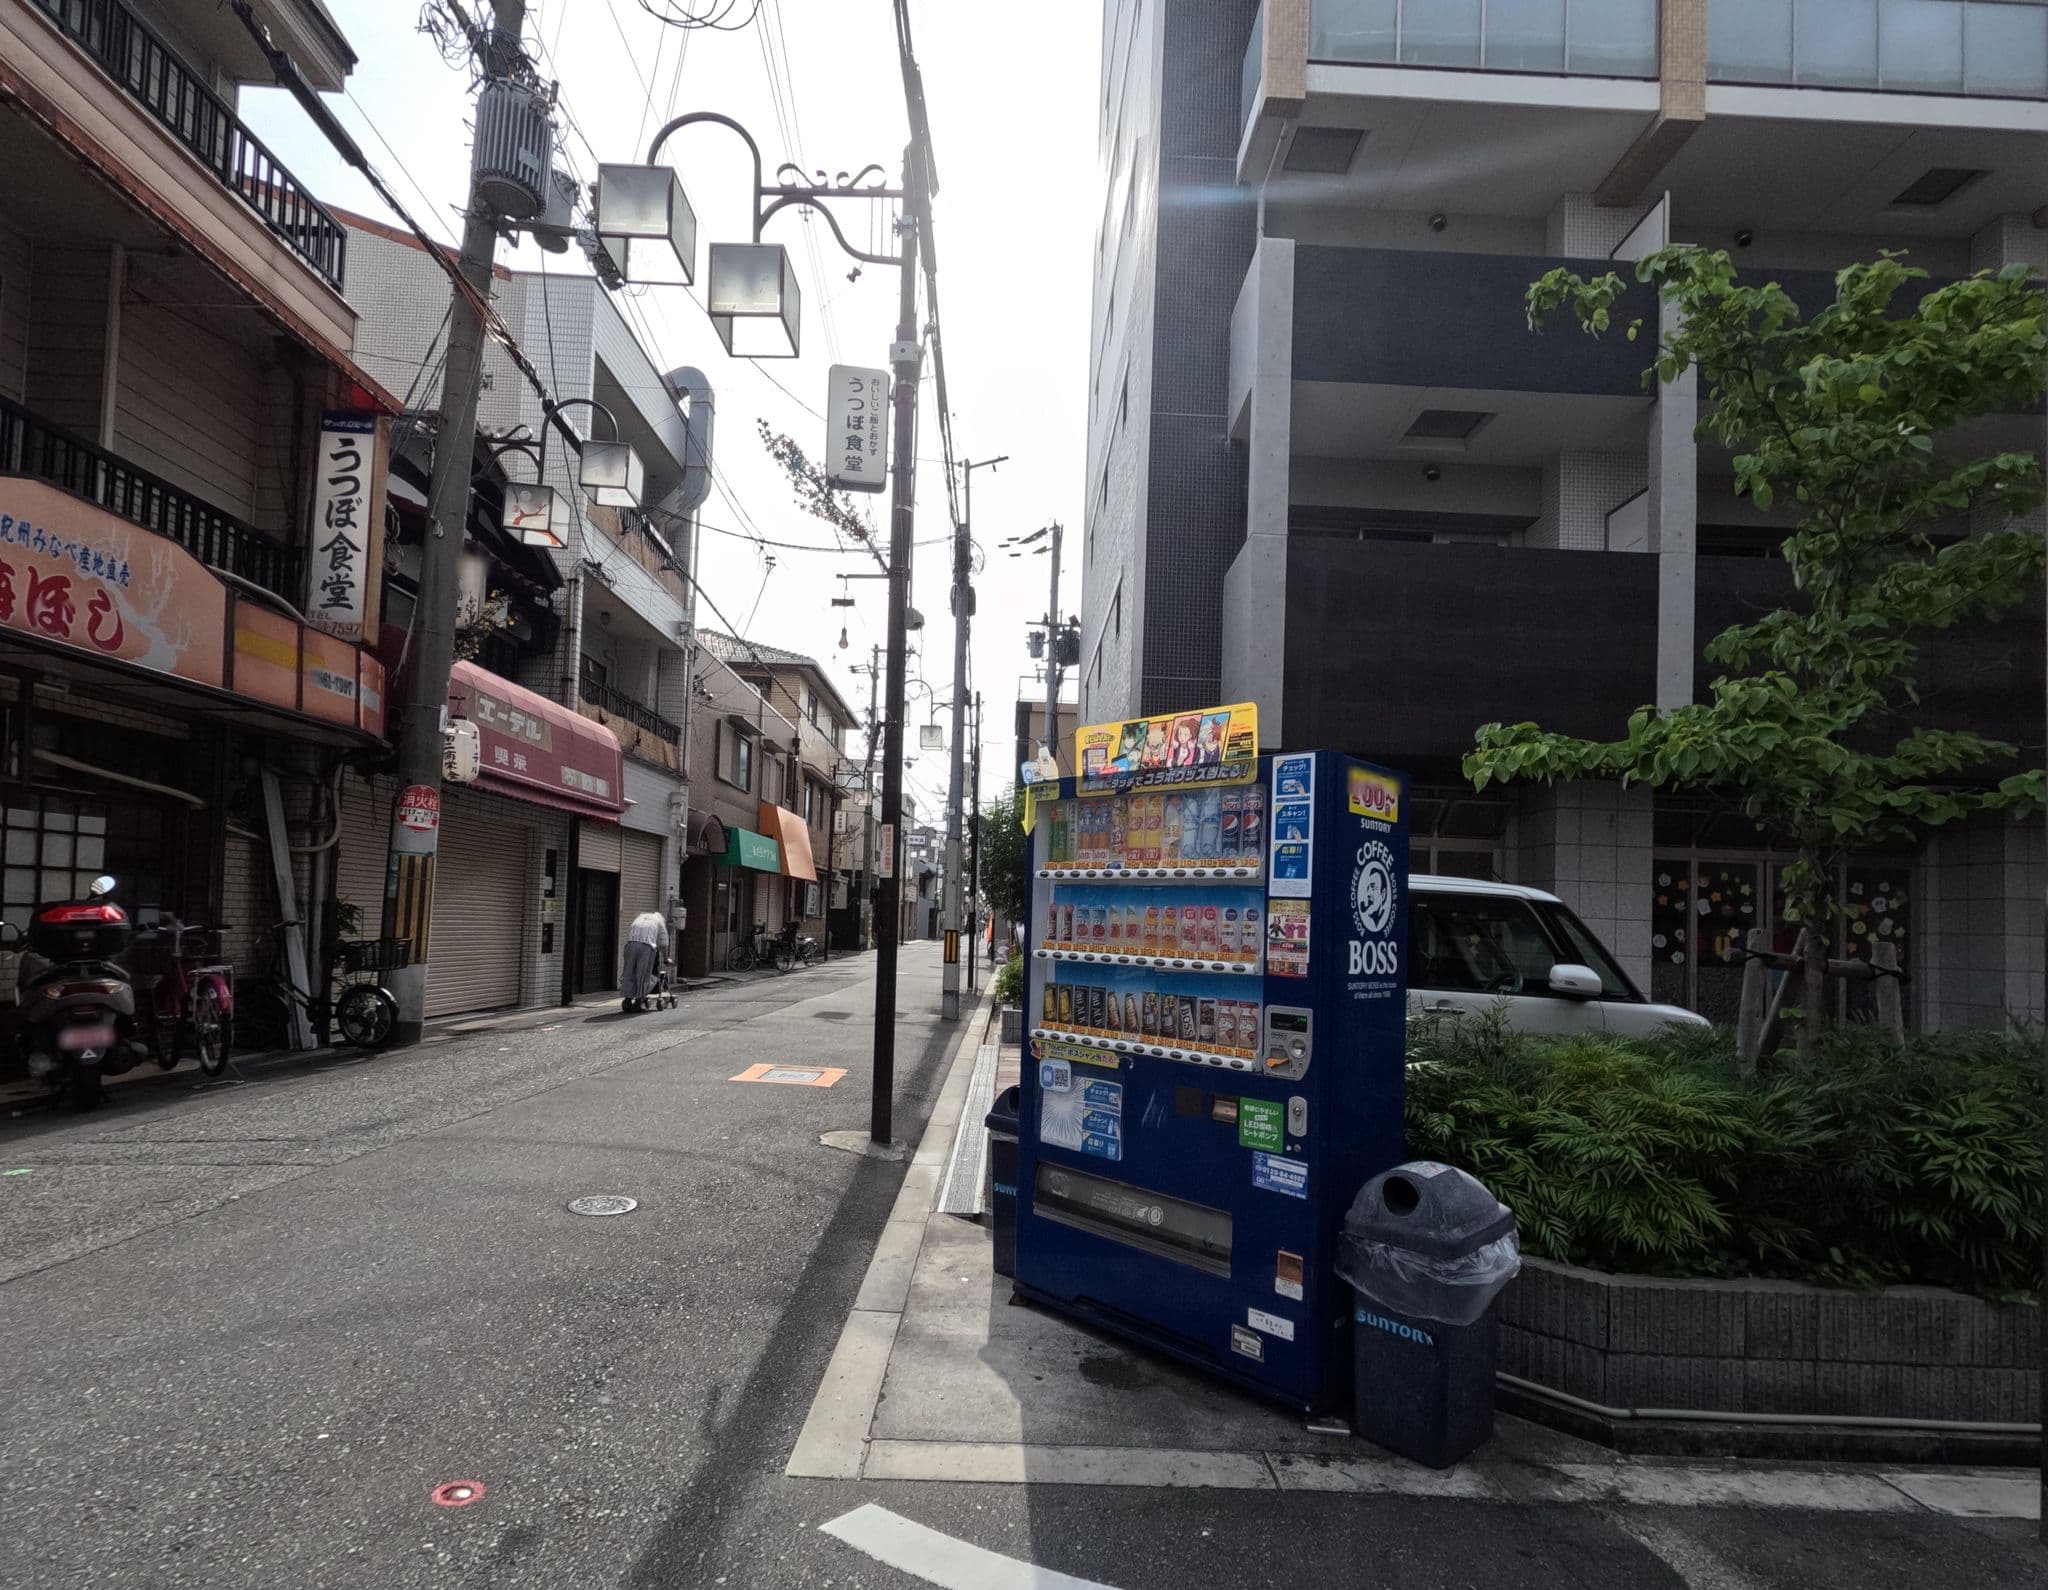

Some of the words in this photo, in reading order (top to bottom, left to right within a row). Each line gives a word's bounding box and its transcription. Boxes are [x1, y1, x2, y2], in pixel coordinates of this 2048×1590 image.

[844, 377, 865, 472] うつぼ食堂
[319, 437, 362, 611] うつぼ食堂
[402, 791, 438, 811] 消火栓
[1360, 817, 1392, 834] SUNTORY
[1356, 840, 1394, 871] COFFEE
[1350, 866, 1361, 910] COFFEE
[1347, 940, 1398, 975] BOSS
[1181, 1006, 1195, 1039] BOSS
[1356, 1307, 1434, 1348] SUNTORY
